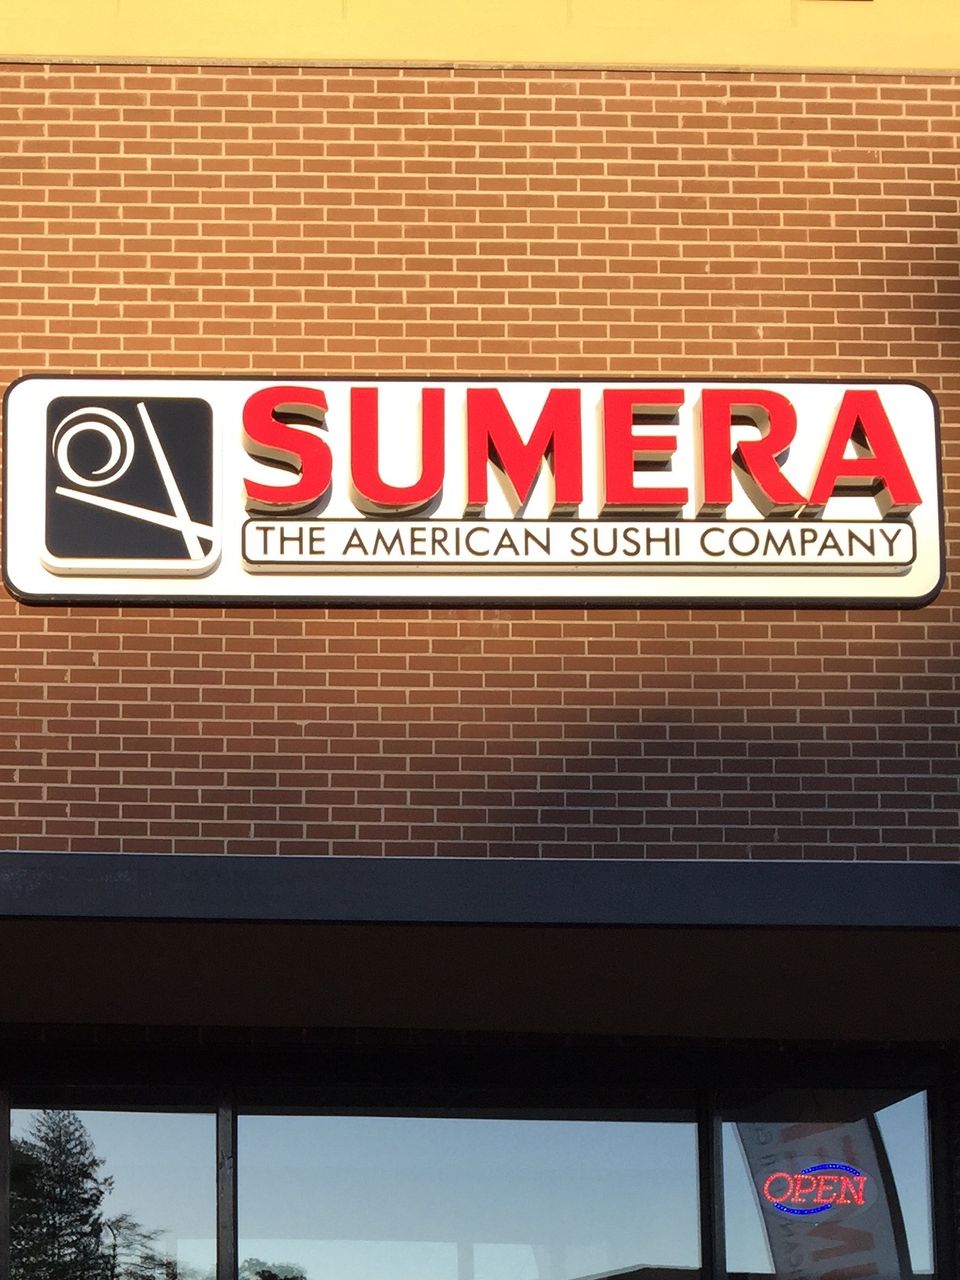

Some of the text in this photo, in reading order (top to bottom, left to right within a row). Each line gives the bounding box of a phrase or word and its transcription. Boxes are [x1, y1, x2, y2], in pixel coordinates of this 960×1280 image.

[242, 386, 922, 506] SUMERA
[255, 526, 902, 557] THE AMERICAN SUSHI COMPANY
[763, 1172, 867, 1206] OPEN
